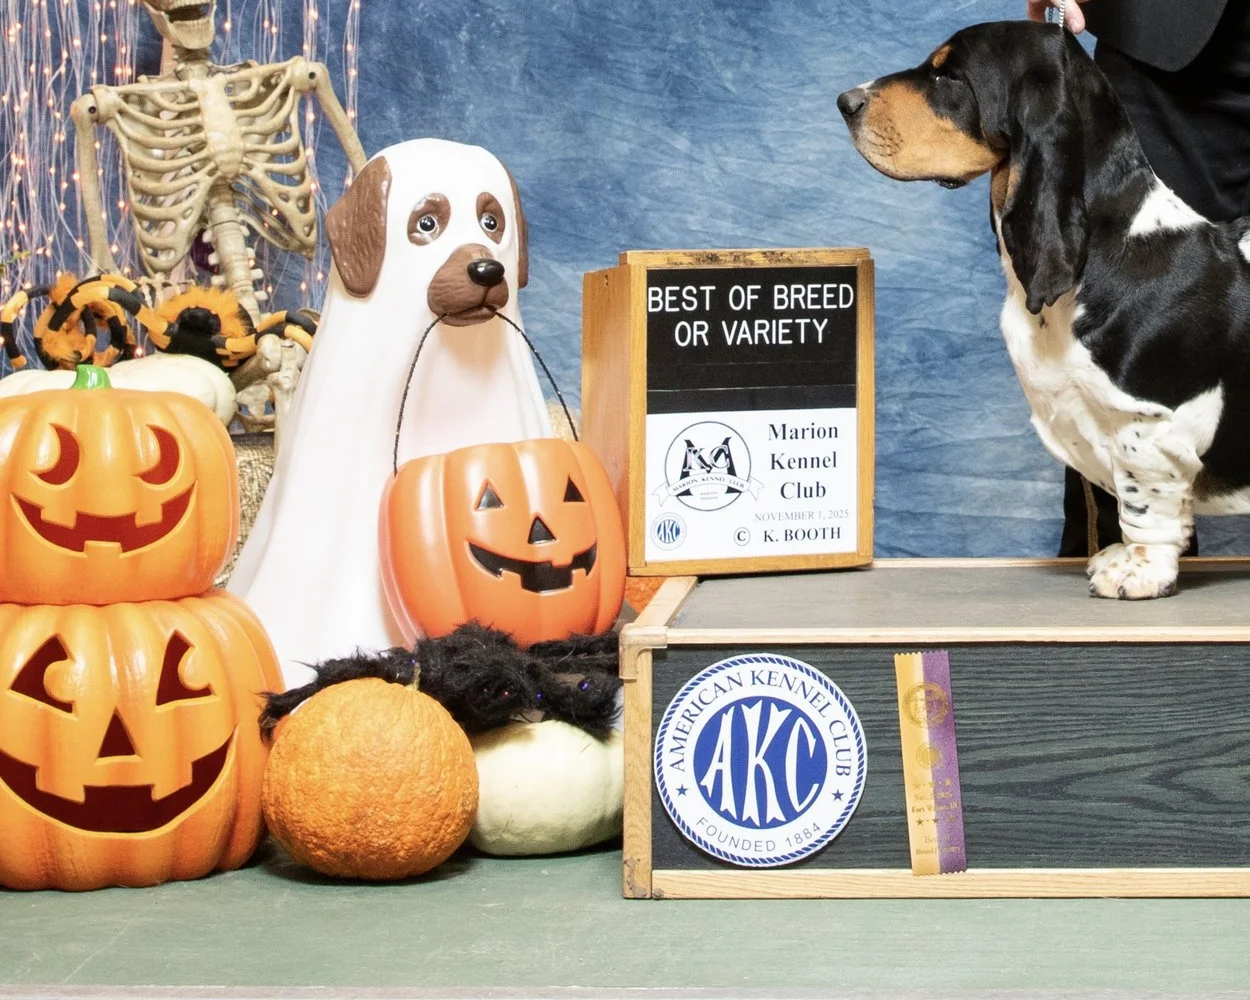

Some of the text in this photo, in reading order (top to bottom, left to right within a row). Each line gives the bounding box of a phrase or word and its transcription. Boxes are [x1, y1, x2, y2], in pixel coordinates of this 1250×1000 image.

[647, 283, 854, 312] BEST OF BREED
[674, 318, 828, 347] OR VARIETY
[767, 422, 839, 441] Marion
[770, 451, 838, 470] Kennel
[779, 481, 827, 499] Club
[754, 510, 815, 522] NOVEMBER
[828, 509, 849, 519] 2025
[763, 529, 779, 542] K.
[784, 526, 841, 541] BOOTH
[669, 671, 743, 772] AMERICAN
[751, 669, 834, 718] KENNEL
[829, 719, 852, 776] CLUB
[700, 699, 820, 827] AKC
[695, 816, 822, 852] FOUNDED 1884
